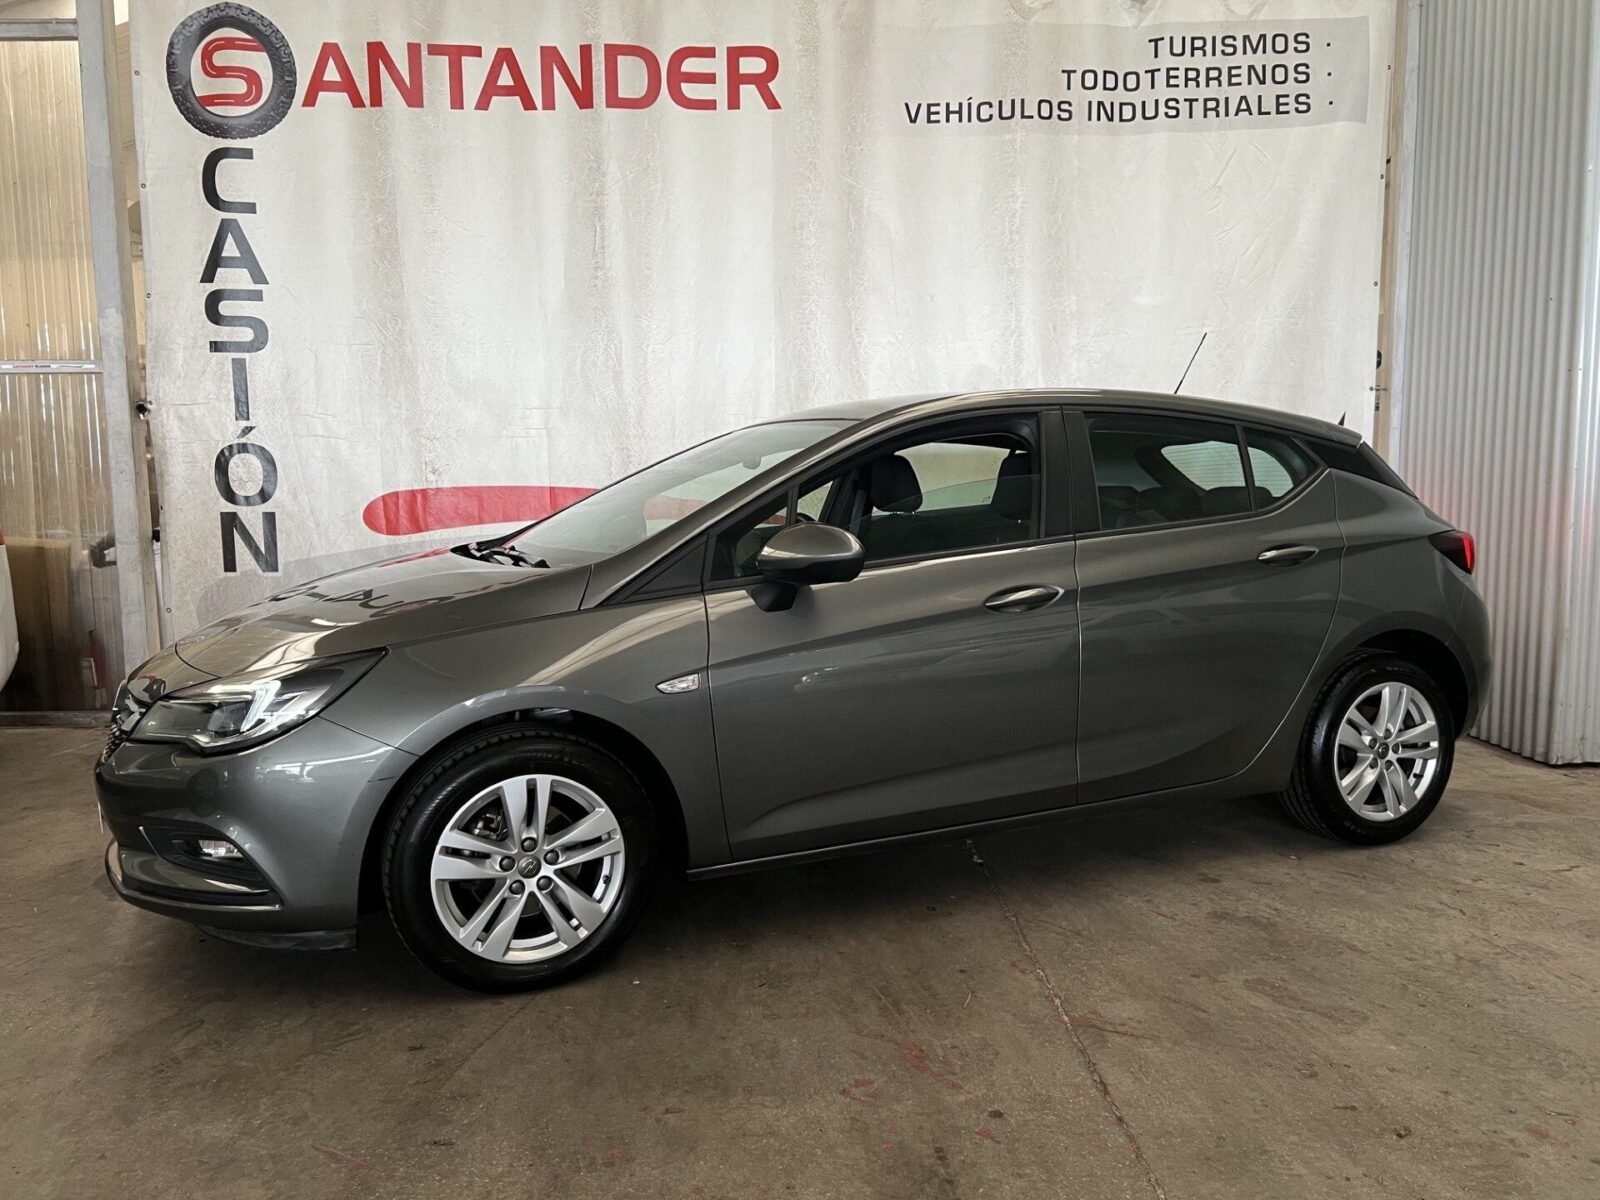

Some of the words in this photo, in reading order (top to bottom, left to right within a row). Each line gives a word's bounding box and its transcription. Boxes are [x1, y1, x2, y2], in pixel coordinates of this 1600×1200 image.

[1147, 33, 1311, 58] TURISMOS
[1061, 62, 1311, 92] TODOTERRENOS
[904, 96, 1073, 124] VEHÍCULOS
[1088, 92, 1311, 122] INDUSTRIALES
